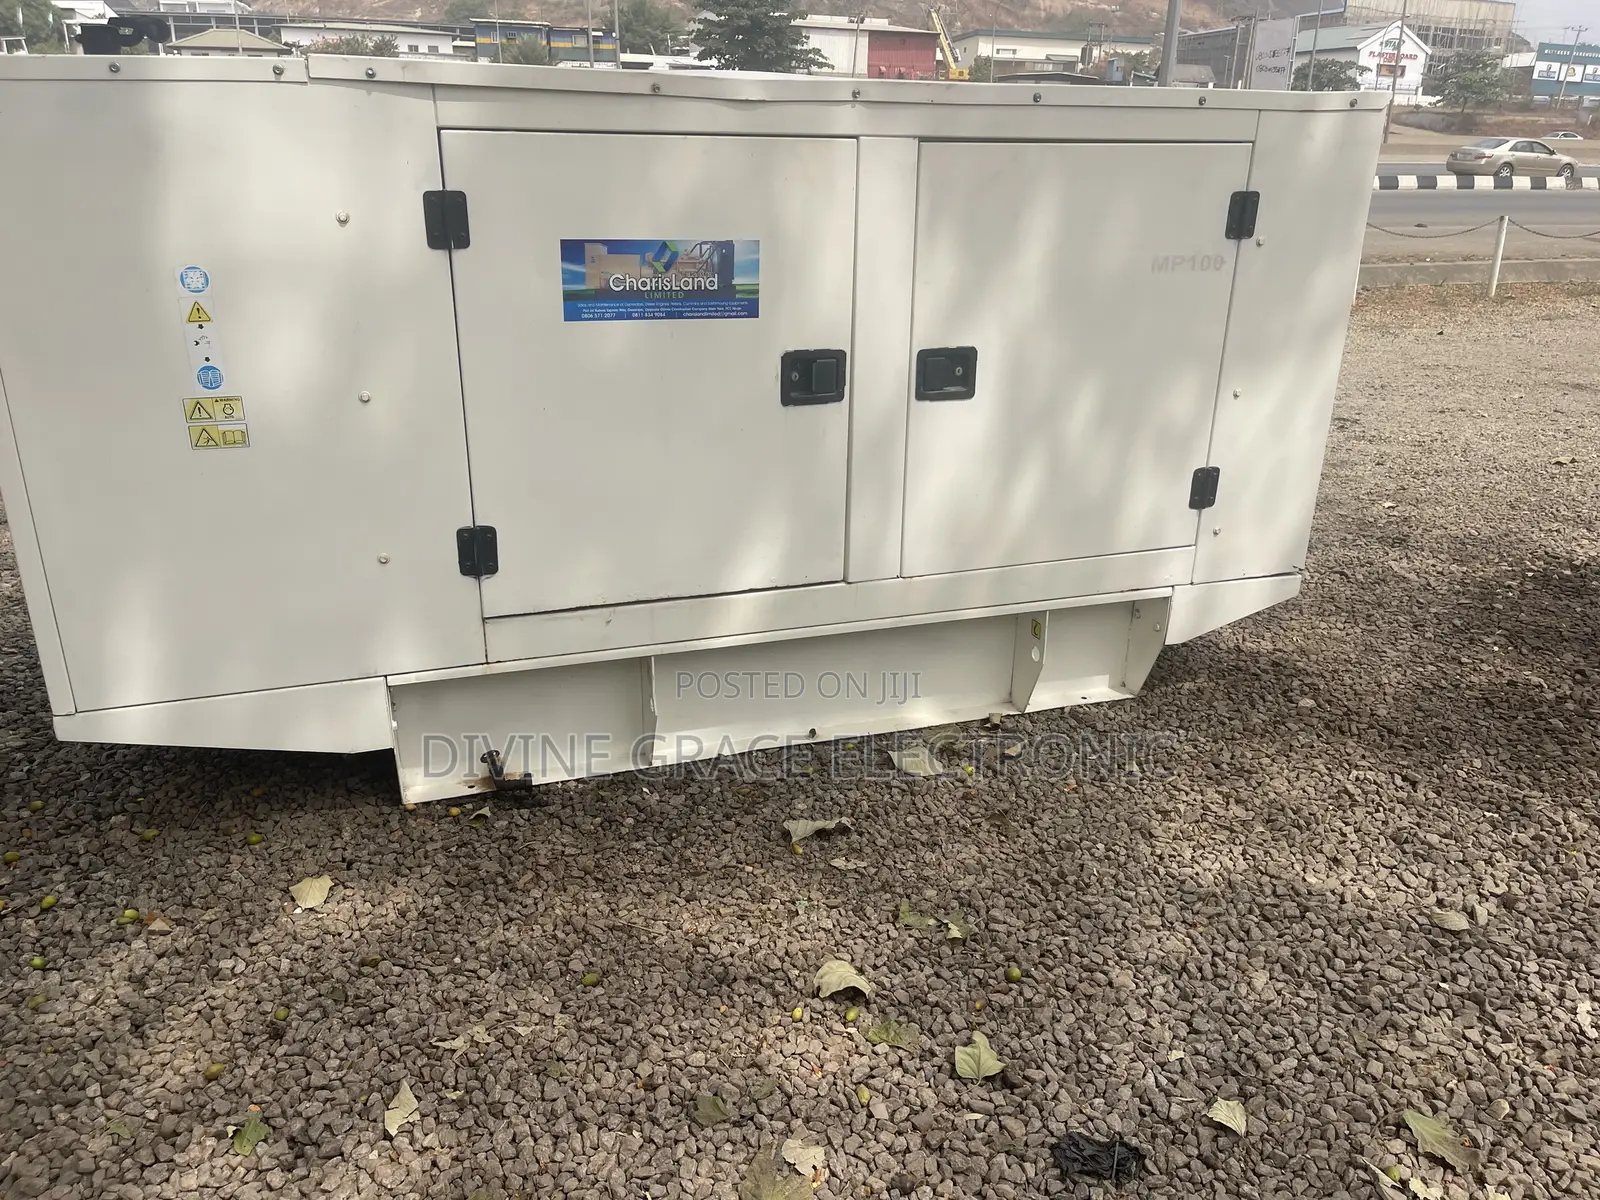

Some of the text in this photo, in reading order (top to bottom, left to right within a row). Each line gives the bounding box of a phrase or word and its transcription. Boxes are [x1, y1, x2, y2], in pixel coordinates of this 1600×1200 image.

[1151, 254, 1224, 274] MP100
[609, 273, 718, 291] CharisLand
[644, 291, 685, 299] LIMITED
